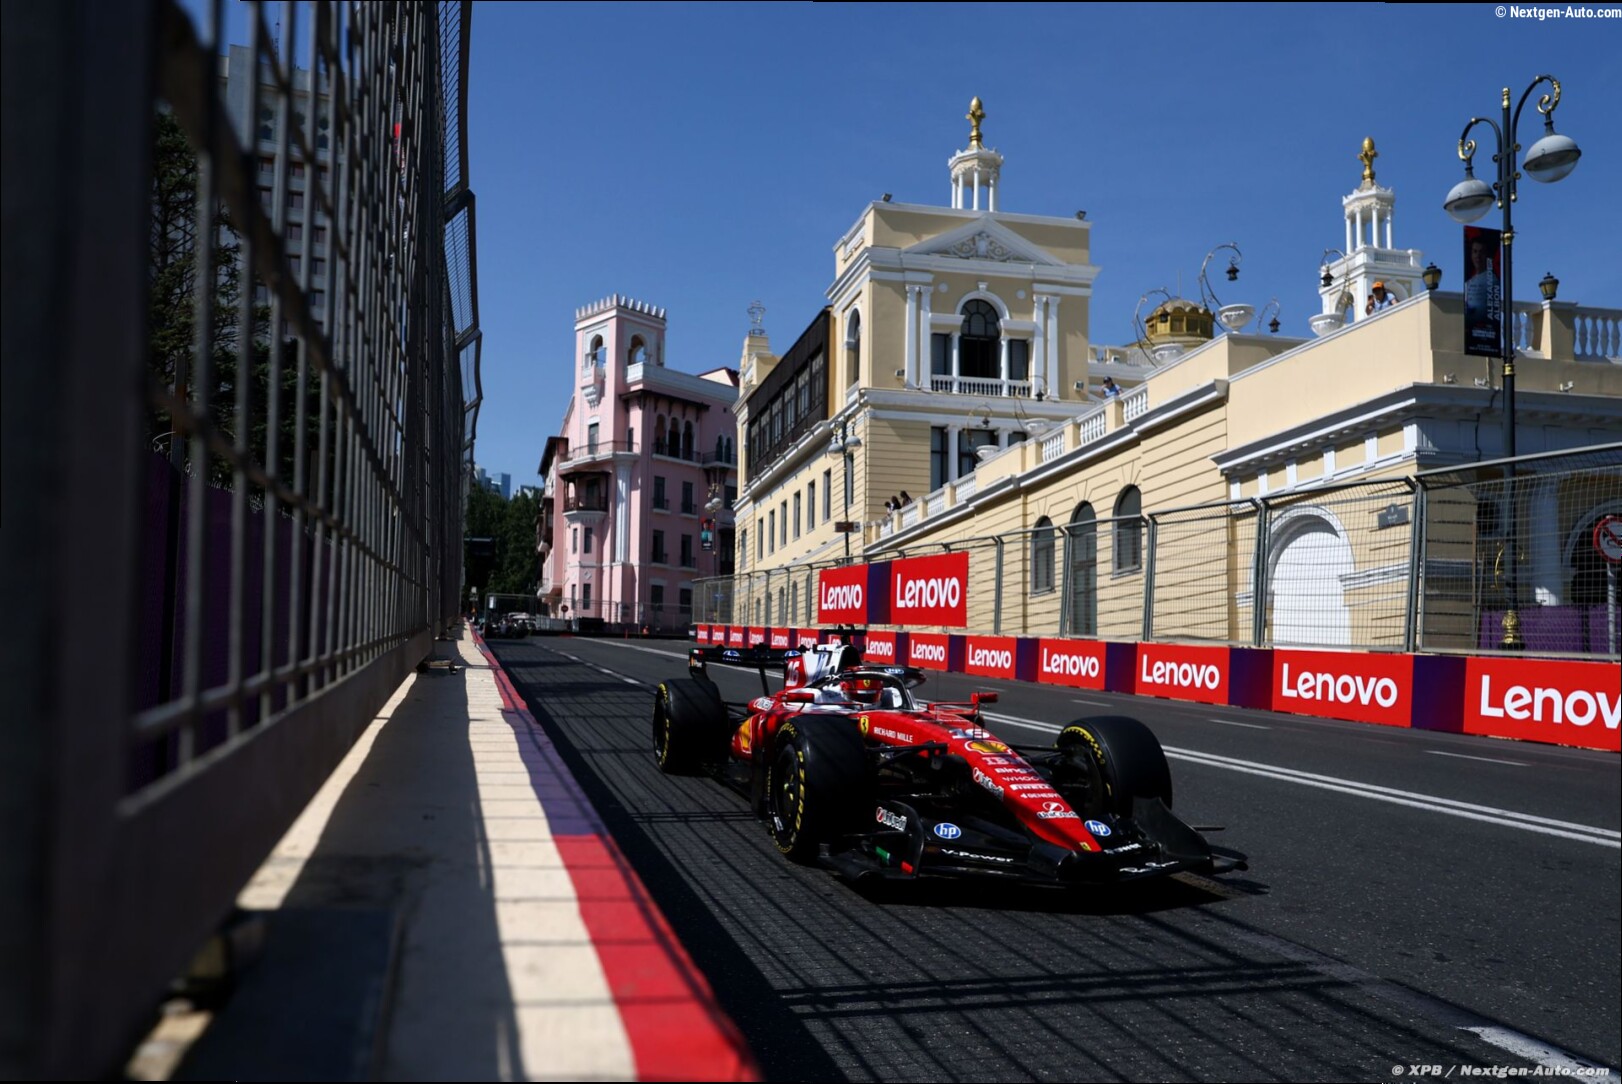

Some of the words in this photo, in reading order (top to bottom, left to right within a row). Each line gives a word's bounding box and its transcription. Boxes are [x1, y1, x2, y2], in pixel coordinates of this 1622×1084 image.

[821, 581, 863, 611] Lenovo
[896, 573, 961, 608] Lenovo
[865, 637, 893, 657] Lenovo
[911, 639, 946, 662] Lenovo
[968, 643, 1012, 669] Lenovo
[785, 660, 801, 687] 16
[1042, 647, 1100, 678] Lenovo
[1141, 654, 1220, 690] Lenovo
[1281, 662, 1398, 708] Lenovo
[1480, 674, 1622, 729] Lenov
[873, 726, 896, 739] RICHARD
[896, 731, 913, 743] MILLE
[937, 823, 959, 839] hp
[1087, 820, 1109, 837] hp
[941, 848, 1014, 862] V-Power
